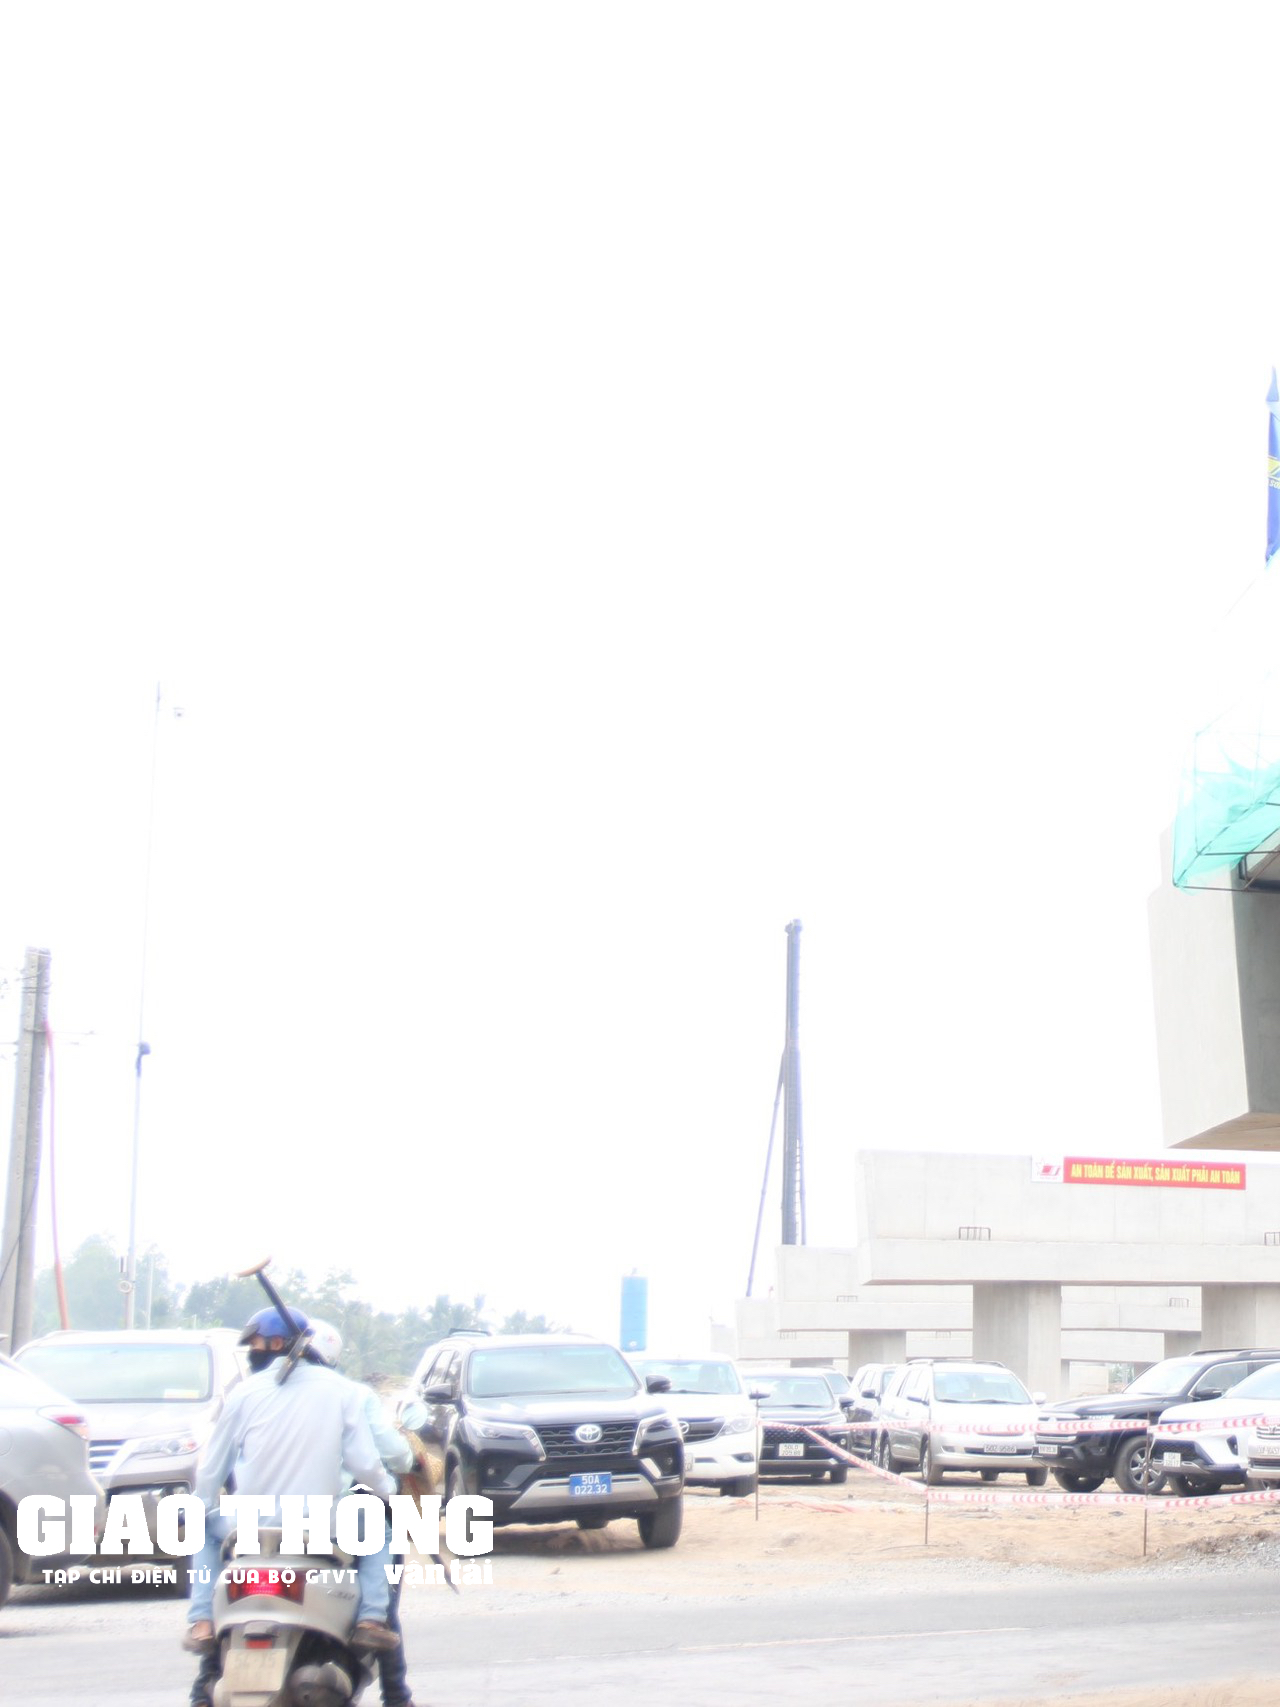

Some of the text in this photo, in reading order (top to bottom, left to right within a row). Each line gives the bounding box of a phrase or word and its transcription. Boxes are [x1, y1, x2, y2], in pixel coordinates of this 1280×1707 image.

[1071, 1163, 1083, 1178] AN
[1084, 1161, 1104, 1178] TOÀN
[1116, 1161, 1132, 1179] SẢN
[1133, 1162, 1154, 1182] XUẤT,
[1155, 1163, 1170, 1181] SẢN
[1171, 1164, 1191, 1182] XUẤT
[1191, 1165, 1209, 1183] PHẢI
[1210, 1169, 1221, 1184] AN
[1222, 1168, 1241, 1185] TOÀN
[581, 1475, 600, 1484] 50A
[574, 1484, 607, 1495] 022.32
